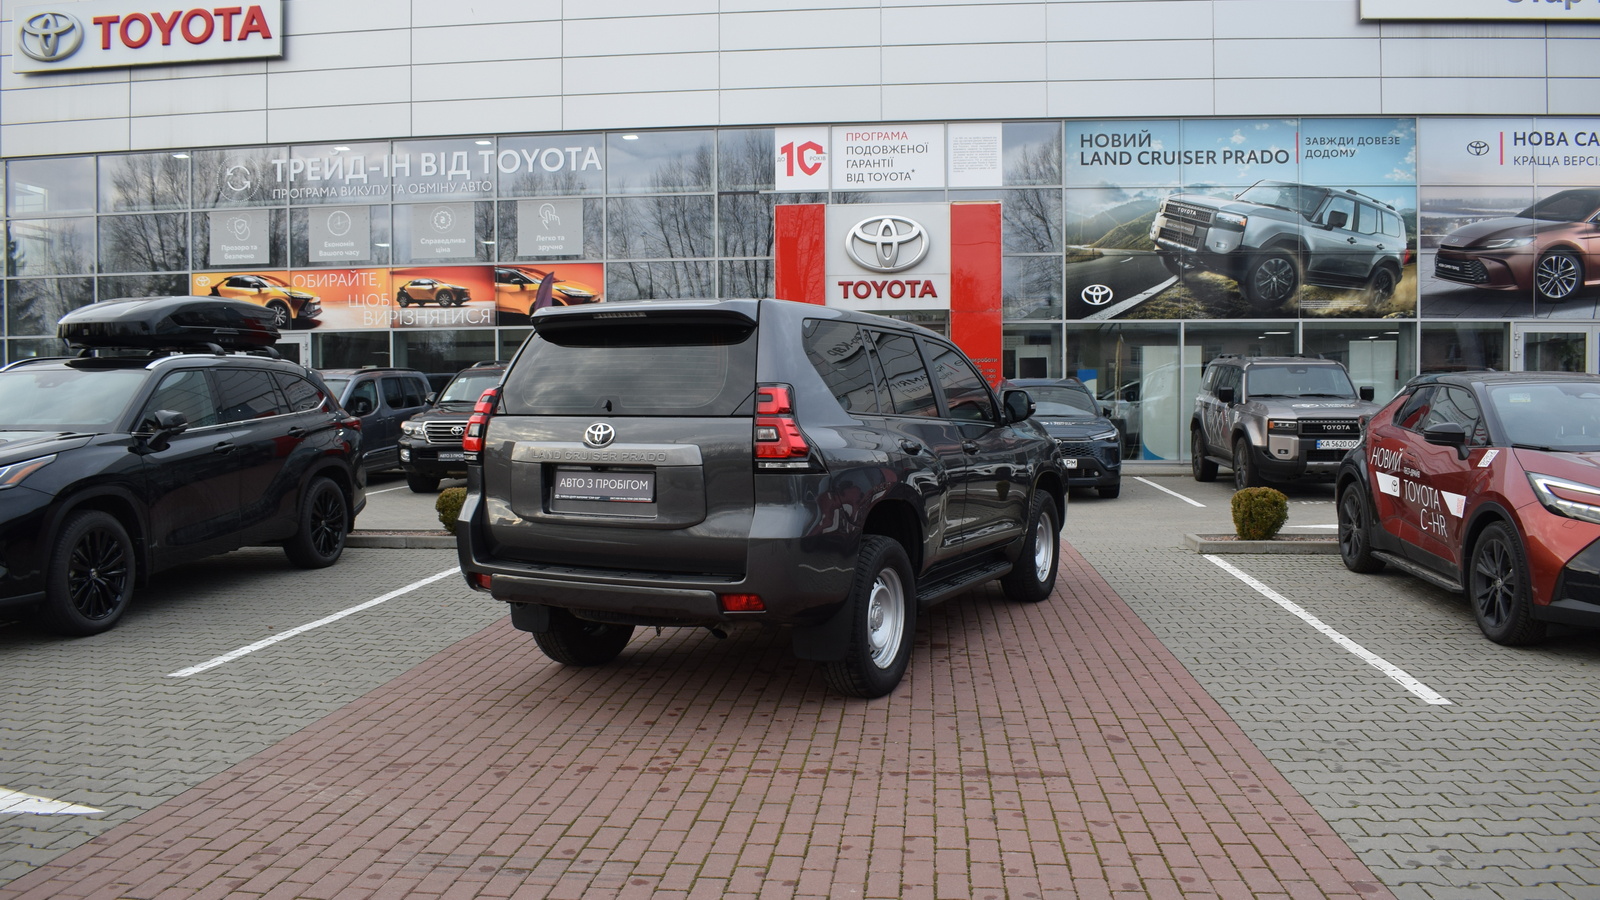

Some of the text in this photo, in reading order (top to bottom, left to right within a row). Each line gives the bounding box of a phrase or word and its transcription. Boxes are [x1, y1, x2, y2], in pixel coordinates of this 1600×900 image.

[93, 5, 272, 50] TOYOTA
[846, 131, 909, 141] ПРОГРАМА
[1080, 129, 1152, 148] НОВИЙ
[1305, 135, 1401, 148] ЗАВЖДИ ДОВЕЗЕ
[1513, 131, 1569, 147] НОВА
[846, 142, 929, 156] ПОДОВЖЕНОЇ
[1305, 149, 1357, 160] ДОДОМУ
[846, 157, 895, 168] ГАРАНТІЇ
[1080, 149, 1290, 165] LAND CRUISER PRADO
[1513, 155, 1600, 167] КРАЩА ВЕРСІ
[271, 146, 603, 184] ТРЕЙД-ІН ВІД TOYOTA
[846, 173, 865, 183] ВІД
[272, 180, 492, 199] ПРОГРАМА ВИКУПУ ТА ОБМІНУ АВТО
[1177, 206, 1197, 216] TOYOTA
[323, 240, 355, 248] Економія
[420, 237, 466, 246] Справедлива
[535, 234, 555, 243] Легко
[221, 244, 250, 252] Прозоро
[319, 249, 360, 257] Вашого часу
[435, 246, 451, 254] ціна
[538, 243, 563, 252] зручно
[224, 251, 255, 260] безпечно
[292, 269, 382, 289] ОБИРАЙТЕ,
[838, 279, 938, 299] TOYOTA
[348, 293, 390, 310] ЩОБ
[363, 308, 491, 326] ВИРІЗНЯТИСЯ
[1331, 440, 1347, 448] 5620
[532, 450, 667, 463] LAND CRUISER PRADO
[1370, 447, 1404, 472] НОВИЙ
[560, 478, 585, 489] АВТО
[595, 479, 649, 490] ПРОБІГОМ
[1403, 479, 1441, 512] TOYOTA
[1420, 508, 1448, 538] C-HR
